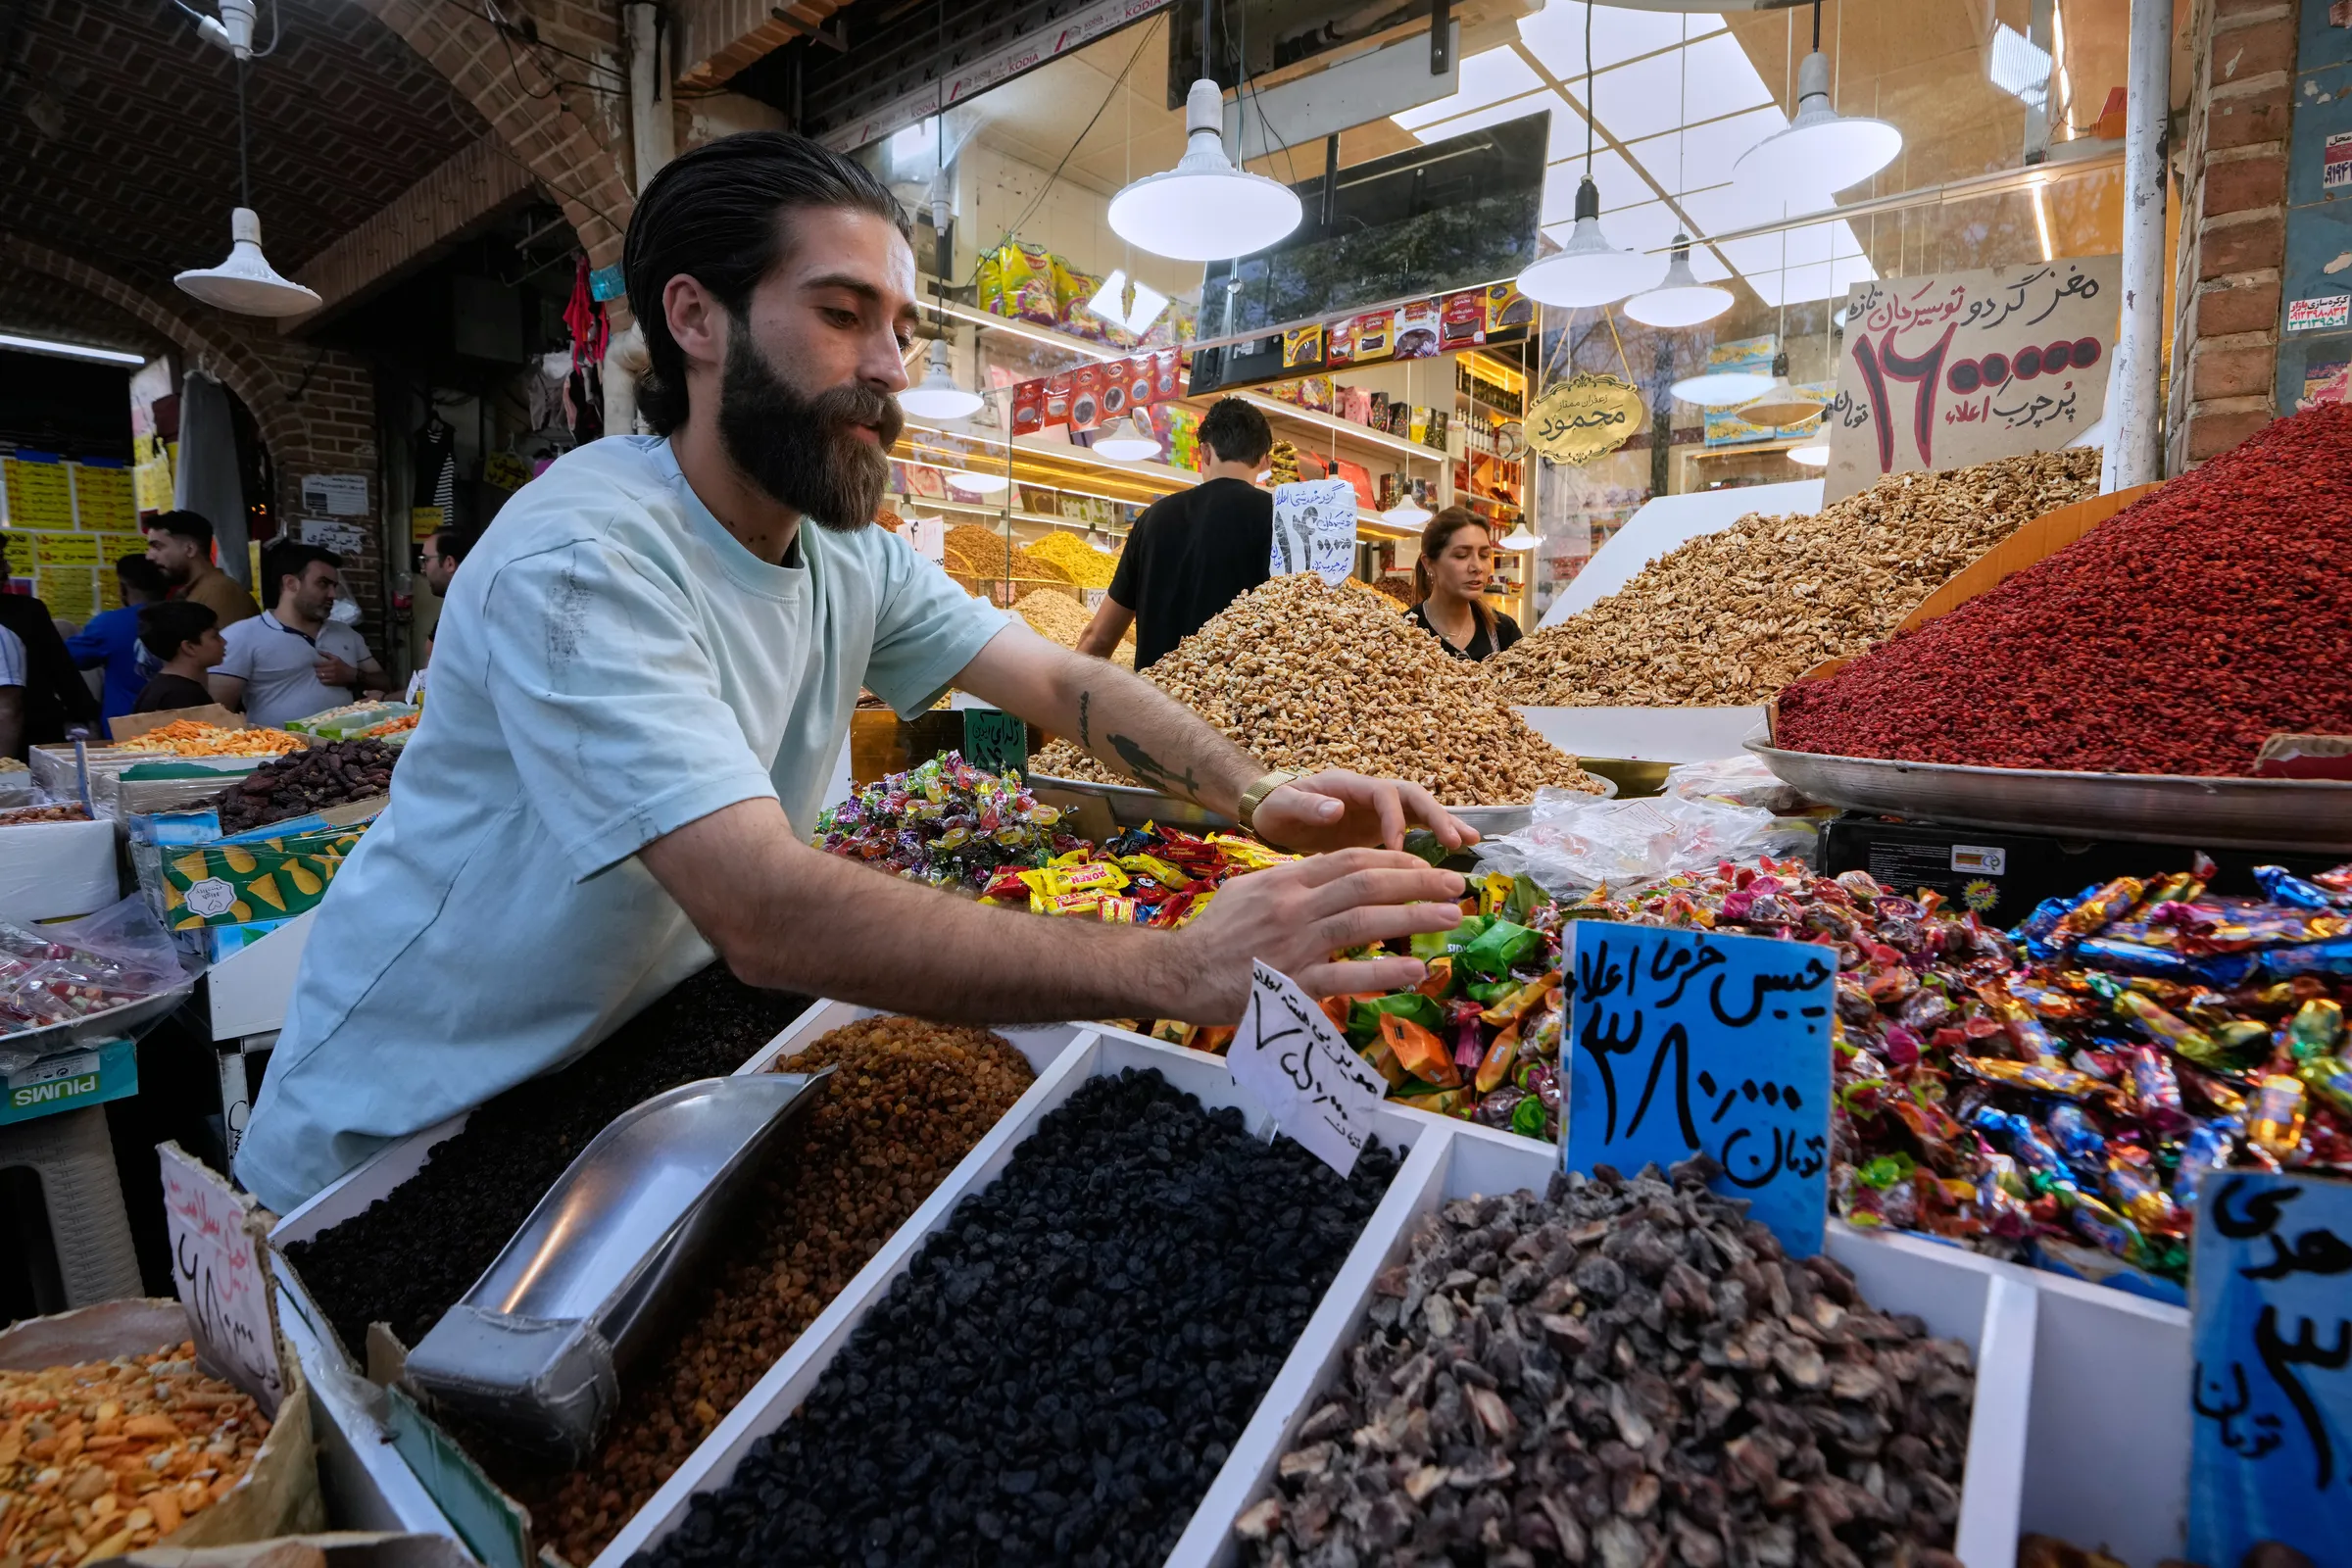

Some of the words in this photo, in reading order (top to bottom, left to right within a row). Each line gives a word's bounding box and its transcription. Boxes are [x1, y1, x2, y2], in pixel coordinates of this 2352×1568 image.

[1125, 0, 1161, 18] KODIA
[1008, 53, 1039, 74] KODIA
[1961, 268, 2050, 329] گردو
[2026, 266, 2100, 325] مغز
[2308, 299, 2328, 311] سازی
[2328, 296, 2349, 308] کرکره
[2290, 301, 2308, 313] بازار
[1557, 400, 1580, 413] ممتاز
[1581, 394, 1608, 408] زعفران
[1318, 483, 1346, 504] گردو
[1070, 870, 1107, 885] ROSEN
[194, 884, 222, 895] Quality
[202, 891, 220, 900] High
[1650, 933, 1727, 1008] خرما
[1281, 994, 1311, 1026] هسته
[1311, 1024, 1331, 1049] بی
[1322, 1043, 1379, 1095] مویز
[1721, 1126, 1827, 1189] تومان
